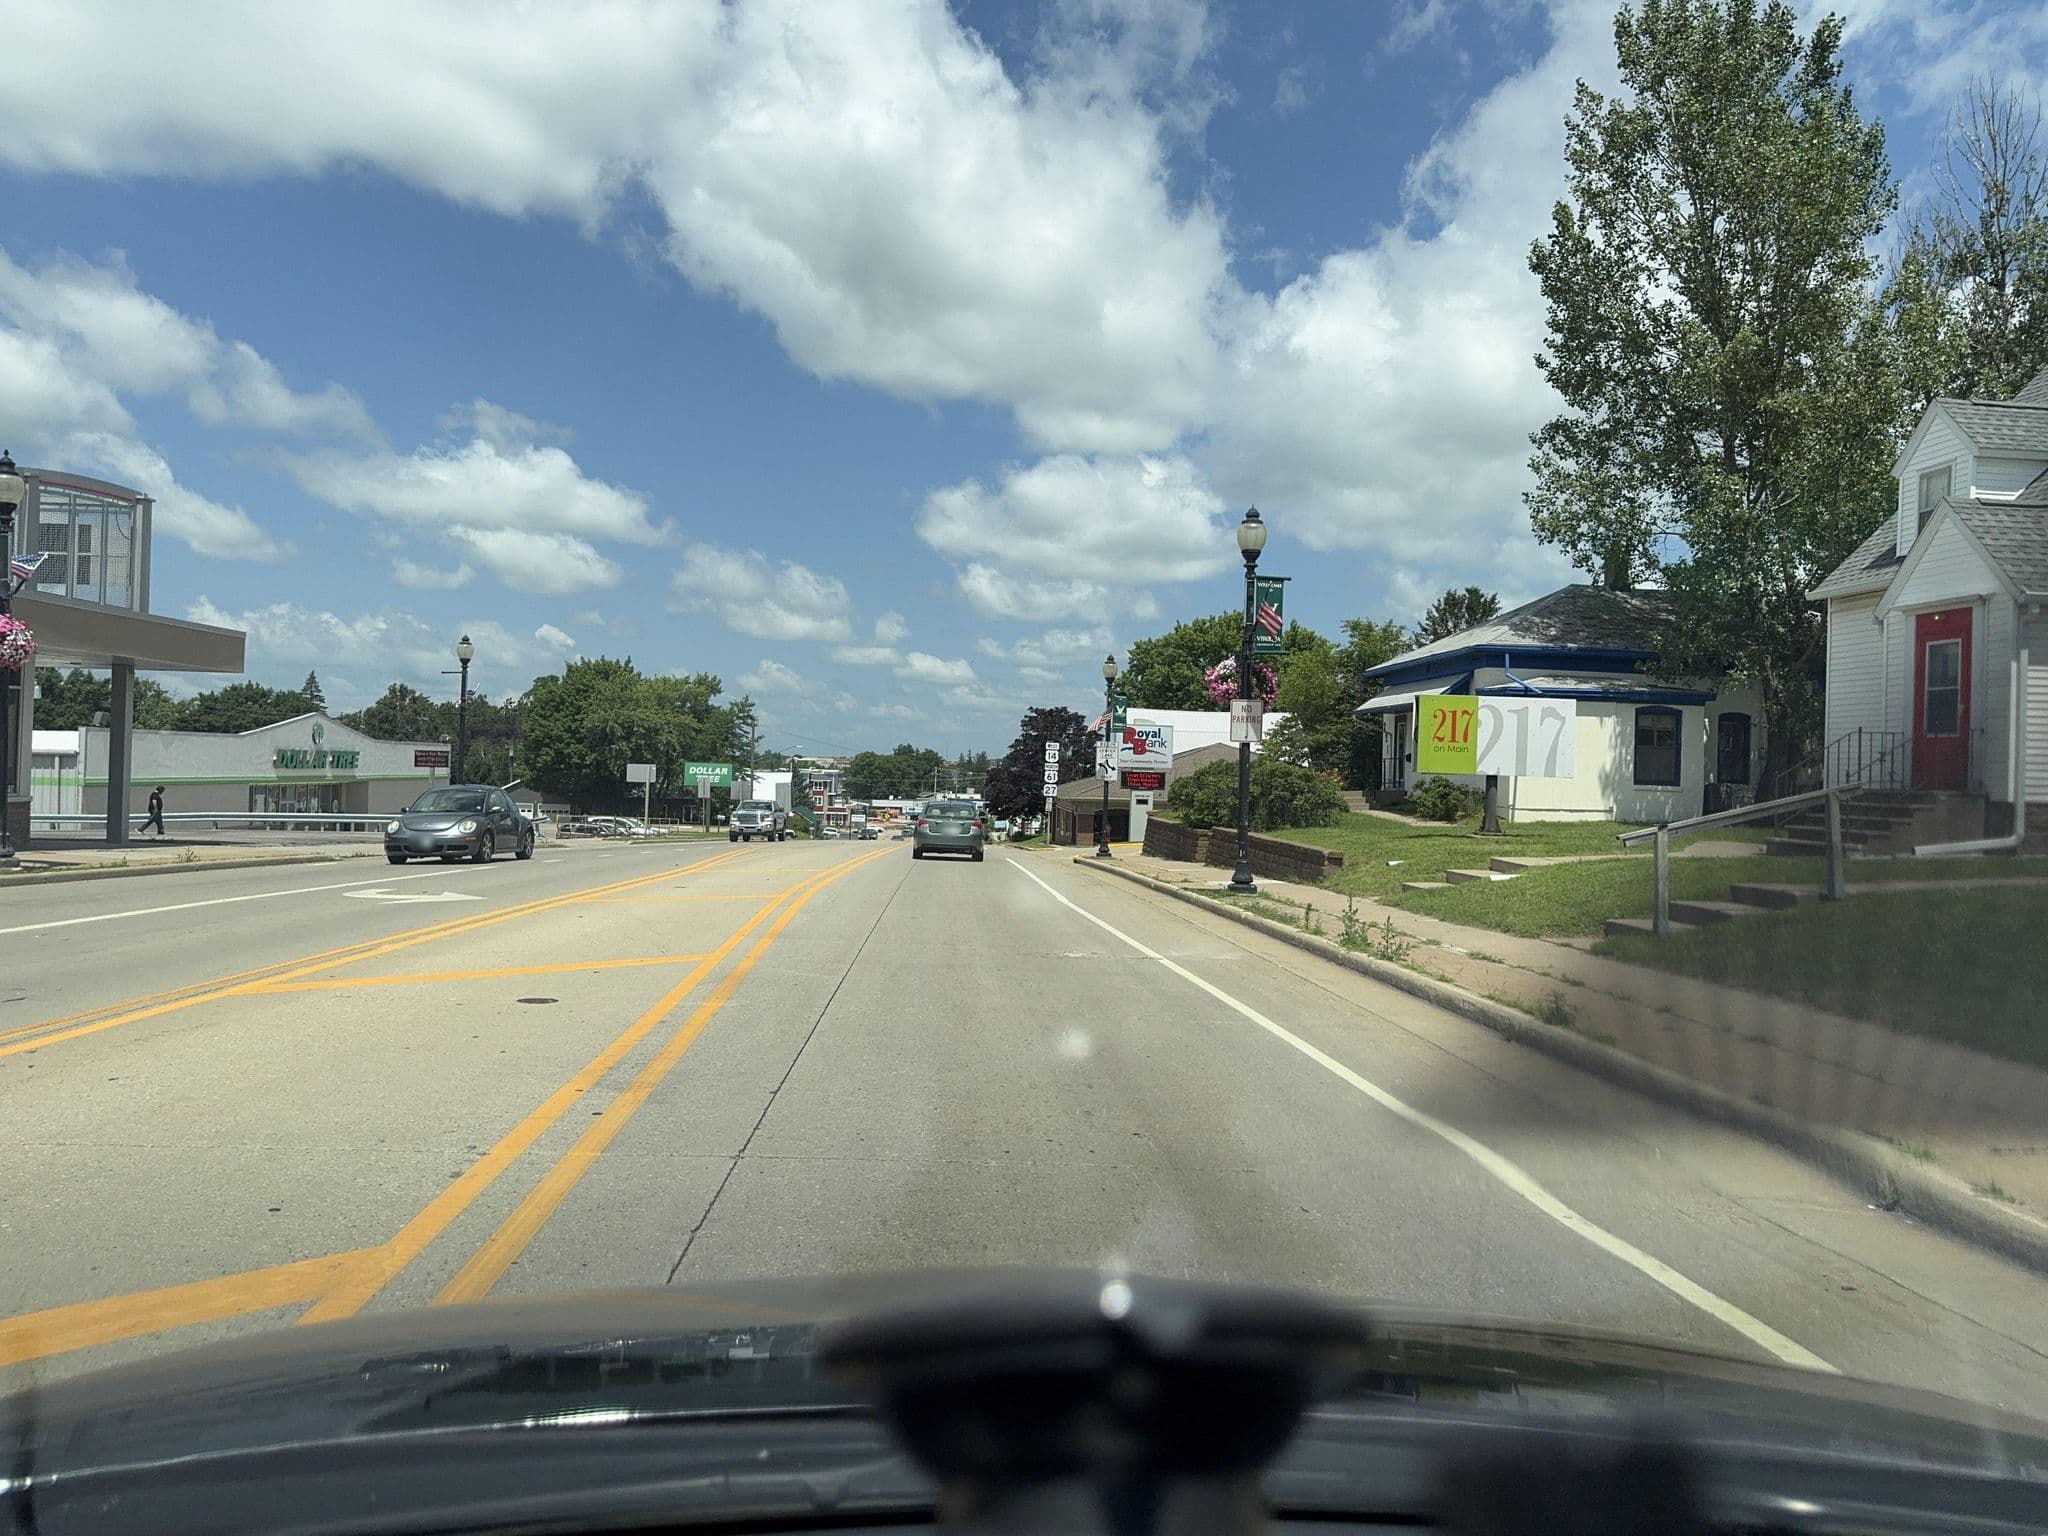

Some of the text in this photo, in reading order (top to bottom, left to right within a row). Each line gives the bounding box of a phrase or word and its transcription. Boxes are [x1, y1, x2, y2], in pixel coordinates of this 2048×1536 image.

[1241, 704, 1252, 713] NO
[1232, 715, 1261, 724] PARKING
[1432, 709, 1475, 744] 217
[1123, 727, 1161, 744] Royal
[1133, 738, 1167, 755] Bank
[1447, 745, 1469, 753] Main
[273, 749, 360, 769] DOLLAR TREE
[1047, 752, 1057, 760] 14
[689, 767, 728, 775] DOLLAR
[1046, 773, 1056, 781] 61
[1045, 786, 1057, 794] 27
